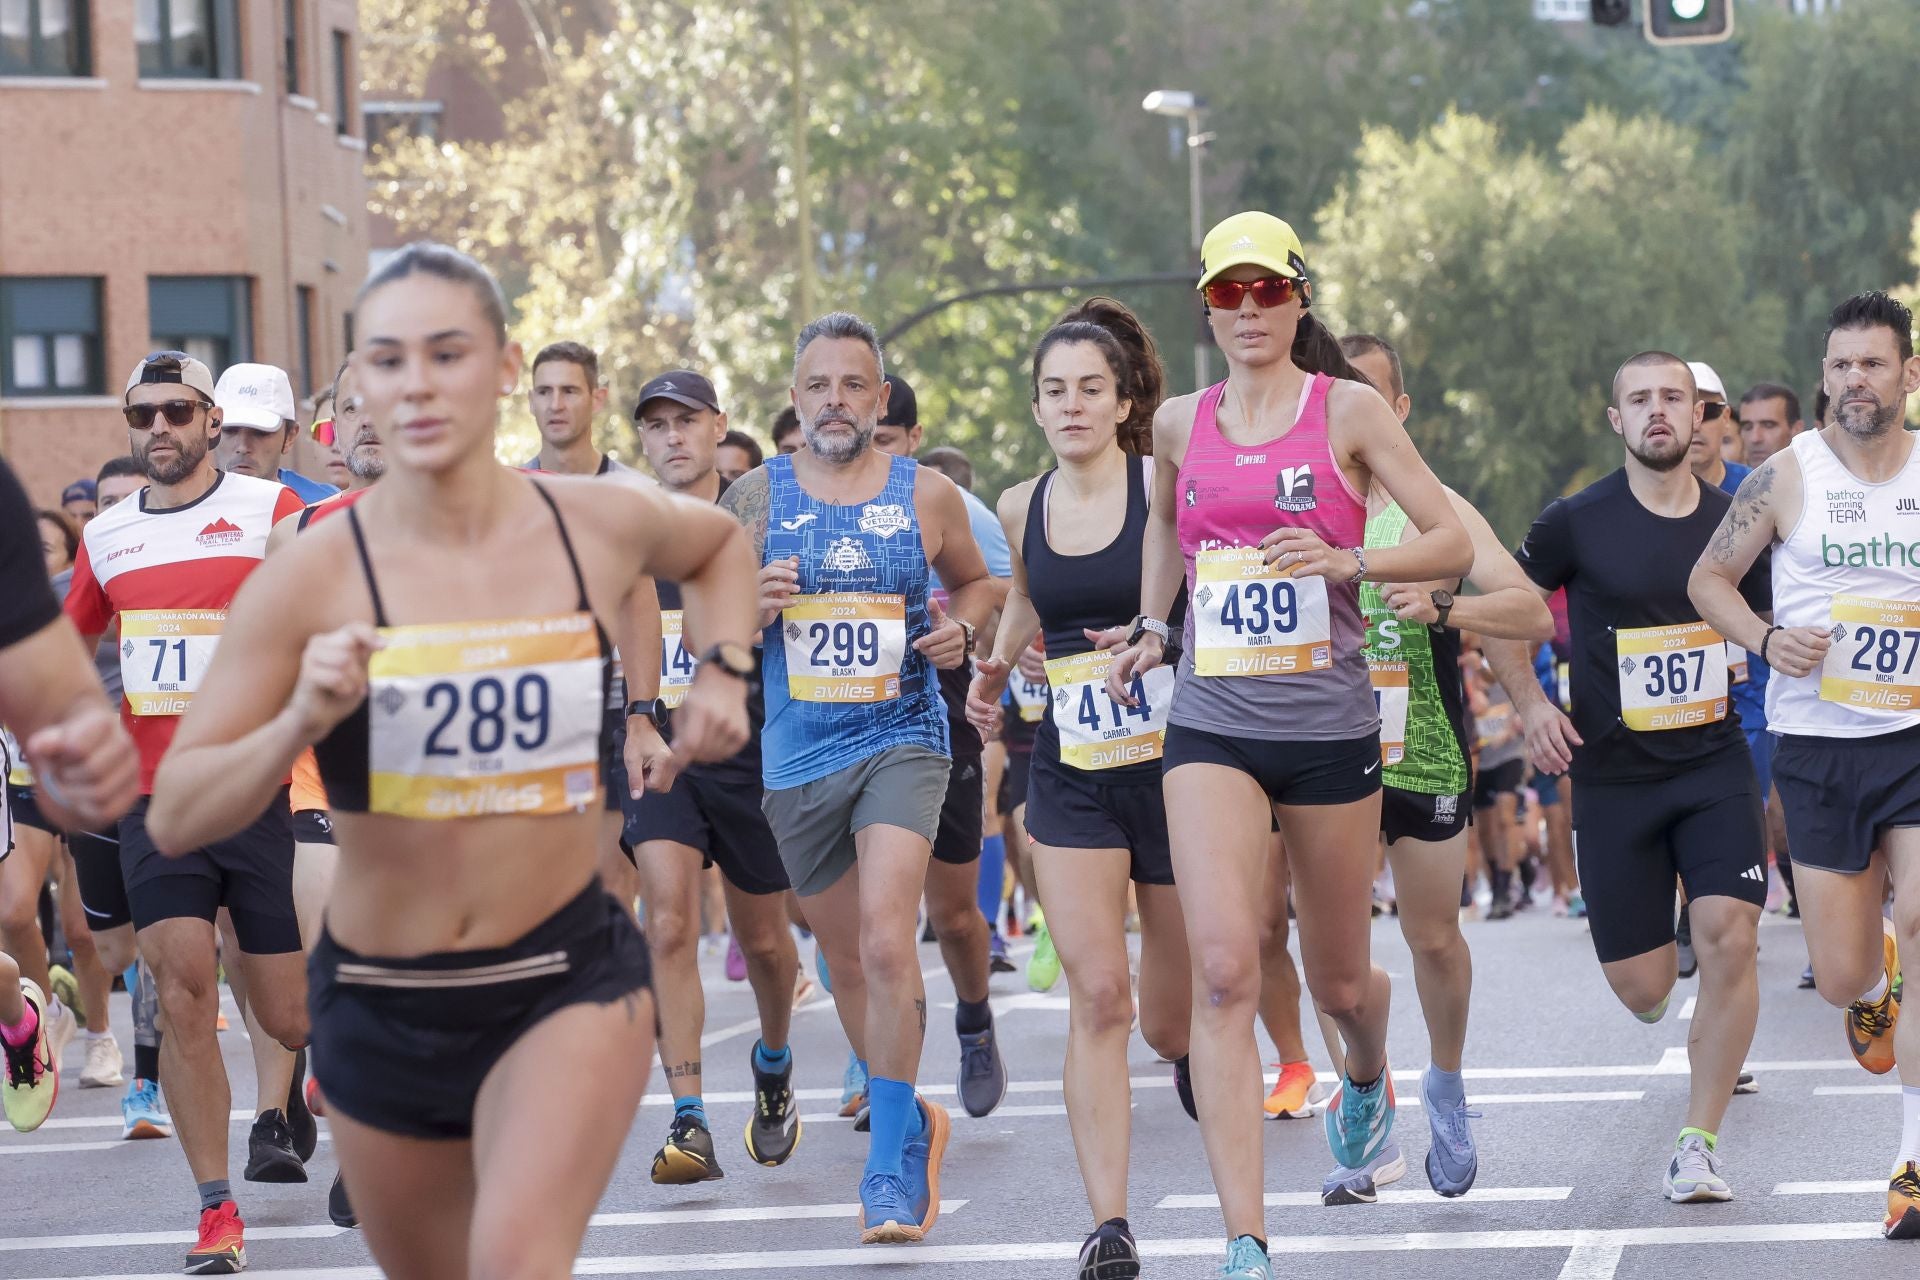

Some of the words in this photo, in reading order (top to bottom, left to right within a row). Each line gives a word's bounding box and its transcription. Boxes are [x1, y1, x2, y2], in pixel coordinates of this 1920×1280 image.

[1826, 490, 1865, 500] bathco
[1275, 500, 1317, 512] FISIORAMA
[1829, 500, 1863, 510] running
[865, 517, 905, 526] VETUSTA
[1827, 510, 1867, 523] TEAM
[1221, 553, 1244, 561] MEDIA
[1241, 565, 1270, 576] 2024
[835, 595, 875, 604] MARATÓN
[876, 595, 902, 604] AVILÉS
[1220, 582, 1298, 635] 439
[1860, 601, 1884, 610] MEDIA
[161, 611, 198, 620] MARATÓN
[199, 611, 226, 620] AVILÉS
[831, 607, 857, 616] 2024
[1880, 613, 1904, 624] 2024
[157, 624, 181, 632] 2024
[1641, 630, 1665, 639] MEDIA
[1666, 625, 1701, 636] MARATÓN
[809, 622, 879, 667] 299
[1247, 635, 1272, 646] MARTA
[1663, 637, 1687, 648] 2024
[1851, 626, 1920, 675] 287
[149, 639, 187, 682] 71
[1071, 656, 1093, 665] MEDIA
[1226, 653, 1298, 672] avilés
[832, 668, 857, 676] BLASKY
[1092, 666, 1110, 675] 202
[1382, 662, 1406, 672] AVILÉS
[1644, 649, 1705, 697] 367
[1875, 674, 1895, 684] MICHI
[158, 683, 180, 691] MIGUEL
[814, 683, 876, 698] avilés
[1670, 695, 1688, 704] DIEGO
[1850, 689, 1913, 706] avilés
[1078, 676, 1153, 731] 414
[423, 673, 551, 757] 289
[1651, 708, 1707, 726] avilés
[1103, 727, 1132, 740] CARMEN
[1090, 741, 1154, 766] avilés
[427, 783, 544, 816] avilés
